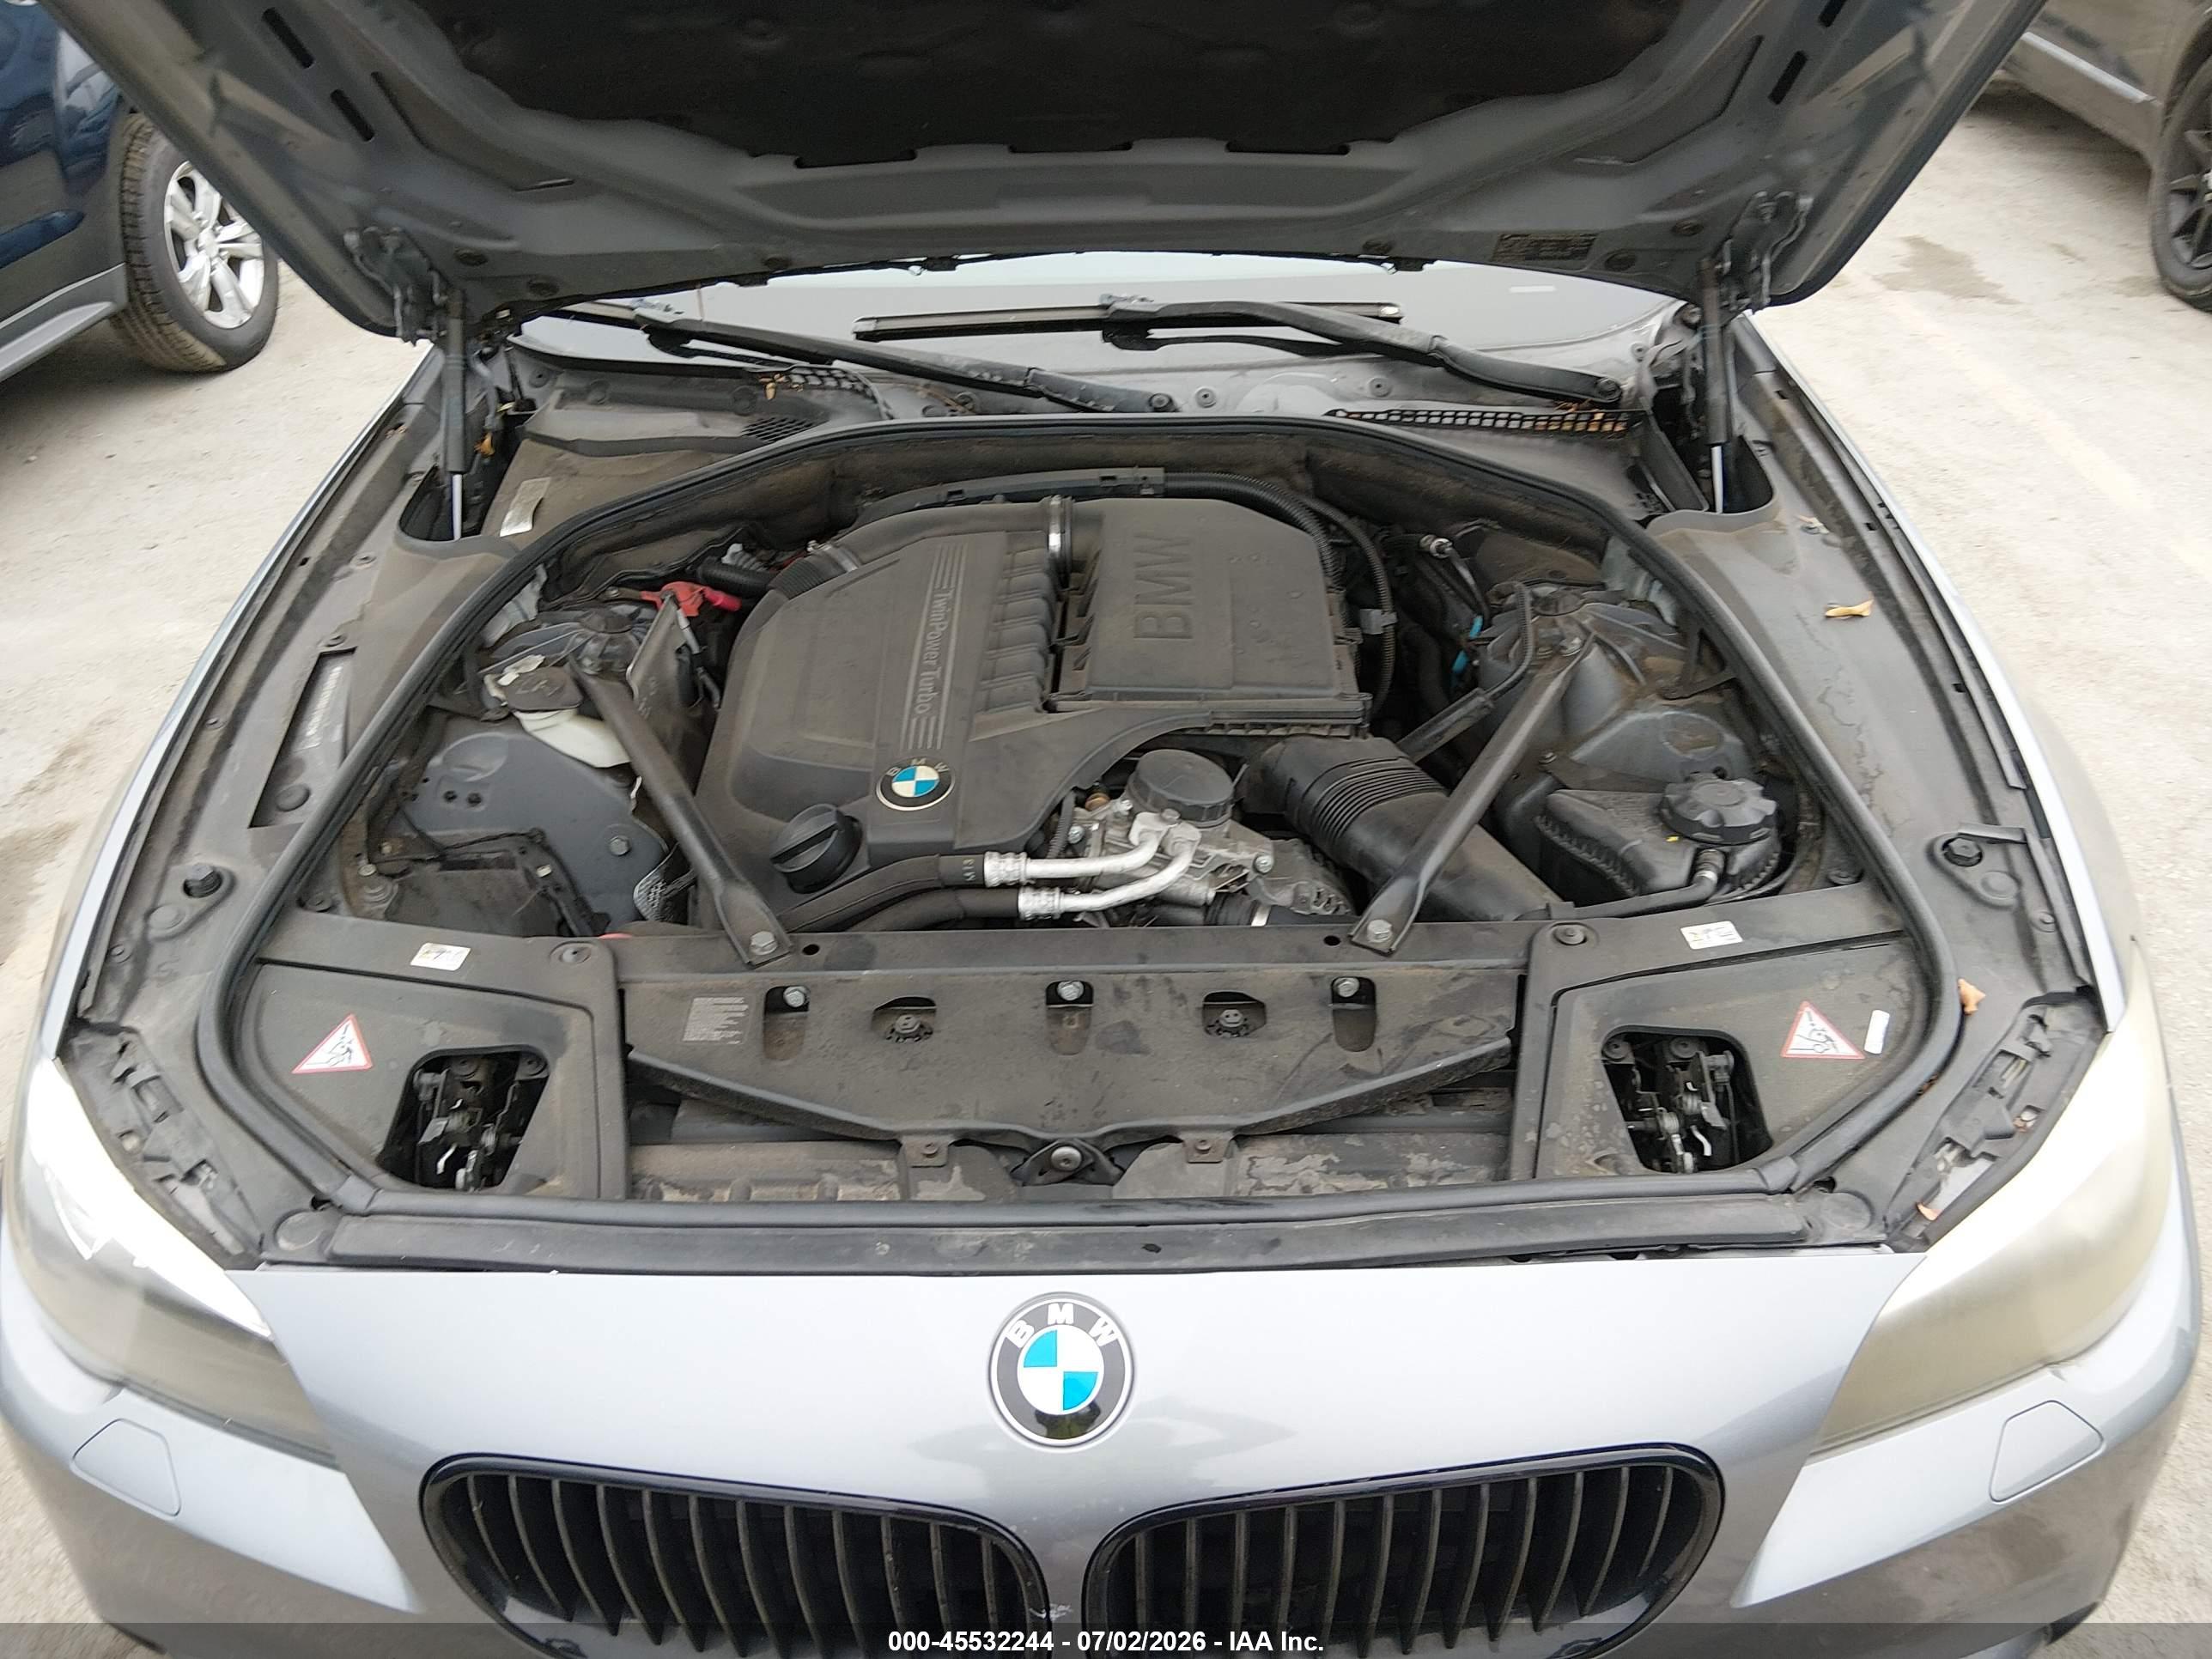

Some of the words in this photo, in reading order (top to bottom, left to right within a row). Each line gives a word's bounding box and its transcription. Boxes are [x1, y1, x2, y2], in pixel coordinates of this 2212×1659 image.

[1133, 534, 1194, 640] BMW
[915, 666, 943, 714] Turbo
[885, 757, 950, 776] BMW
[1005, 1302, 1118, 1348] BMW
